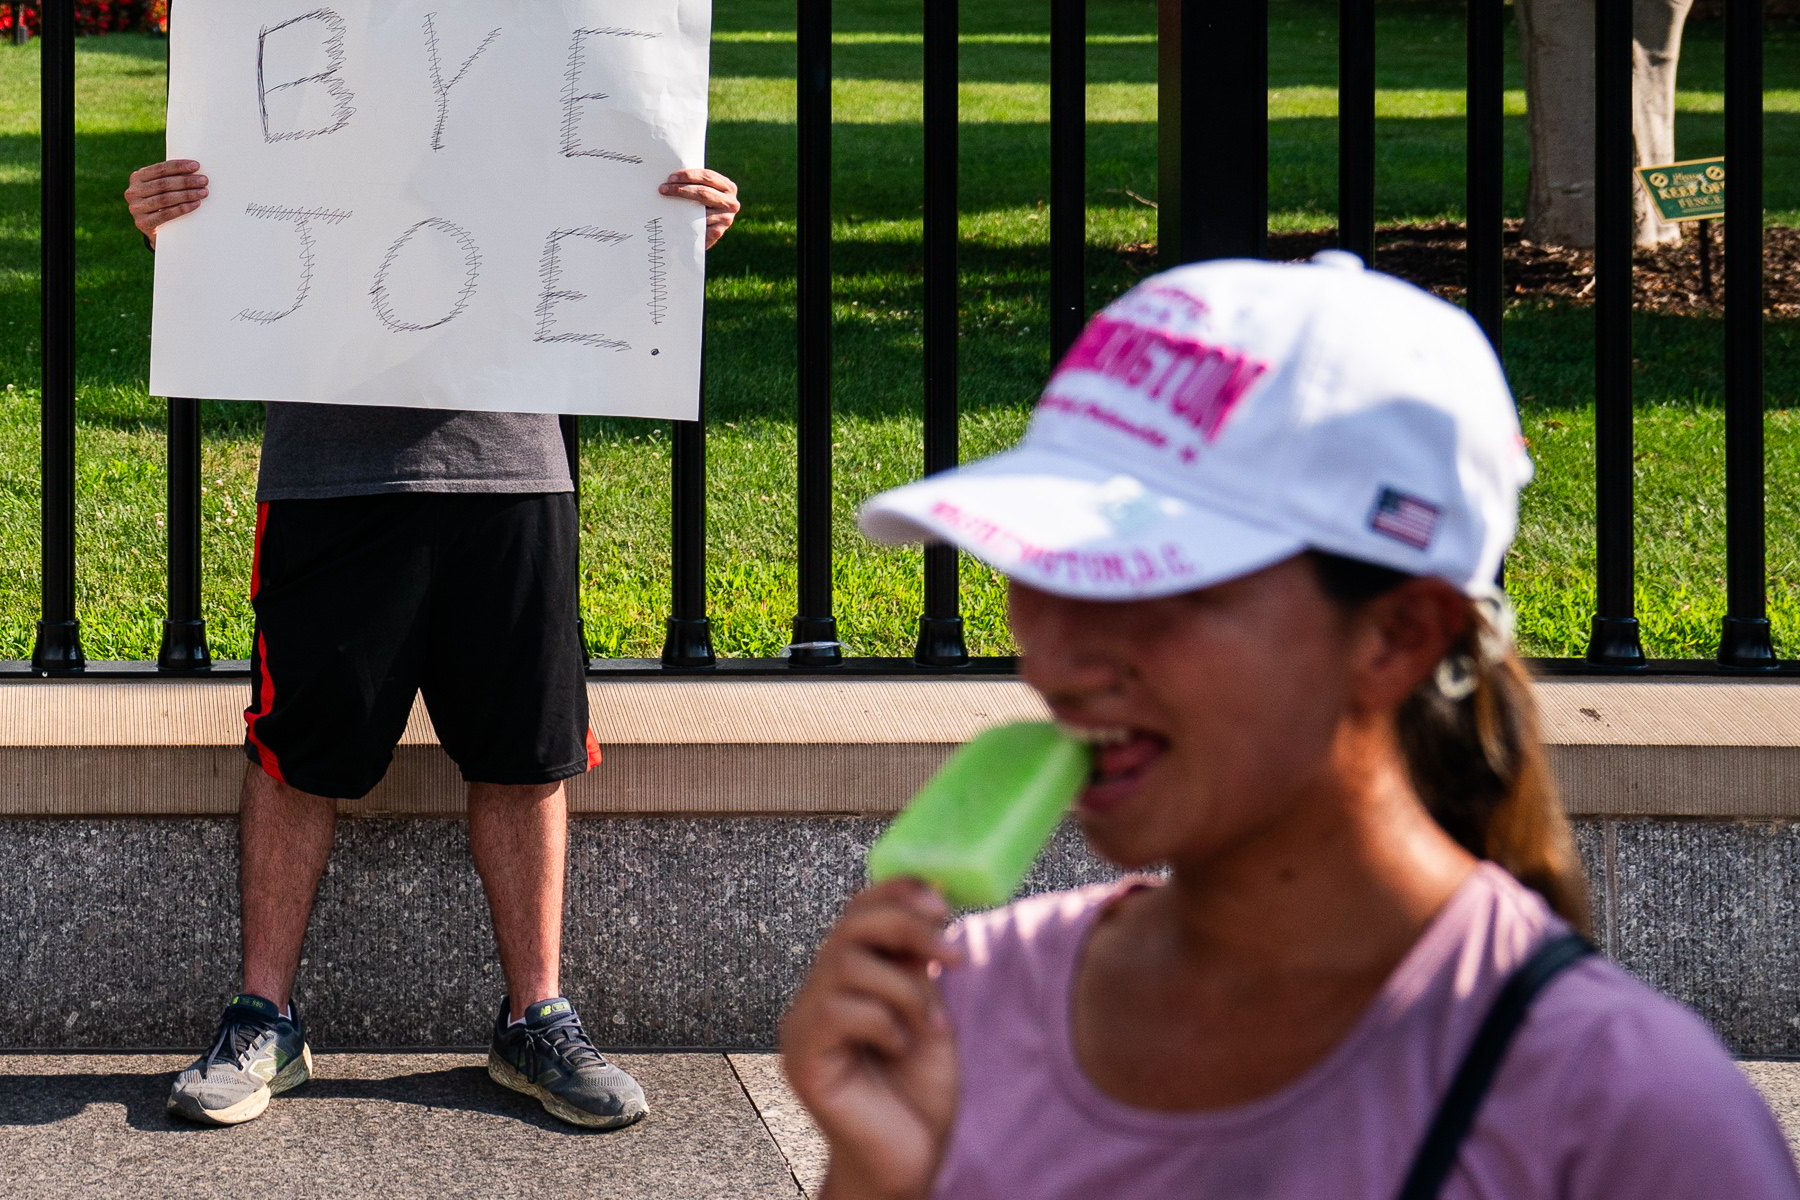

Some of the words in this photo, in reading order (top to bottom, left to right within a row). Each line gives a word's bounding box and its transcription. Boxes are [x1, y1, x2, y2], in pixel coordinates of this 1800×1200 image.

[256, 6, 664, 164] BYE
[1658, 186, 1699, 200] KEEP
[230, 202, 666, 356] JOE!
